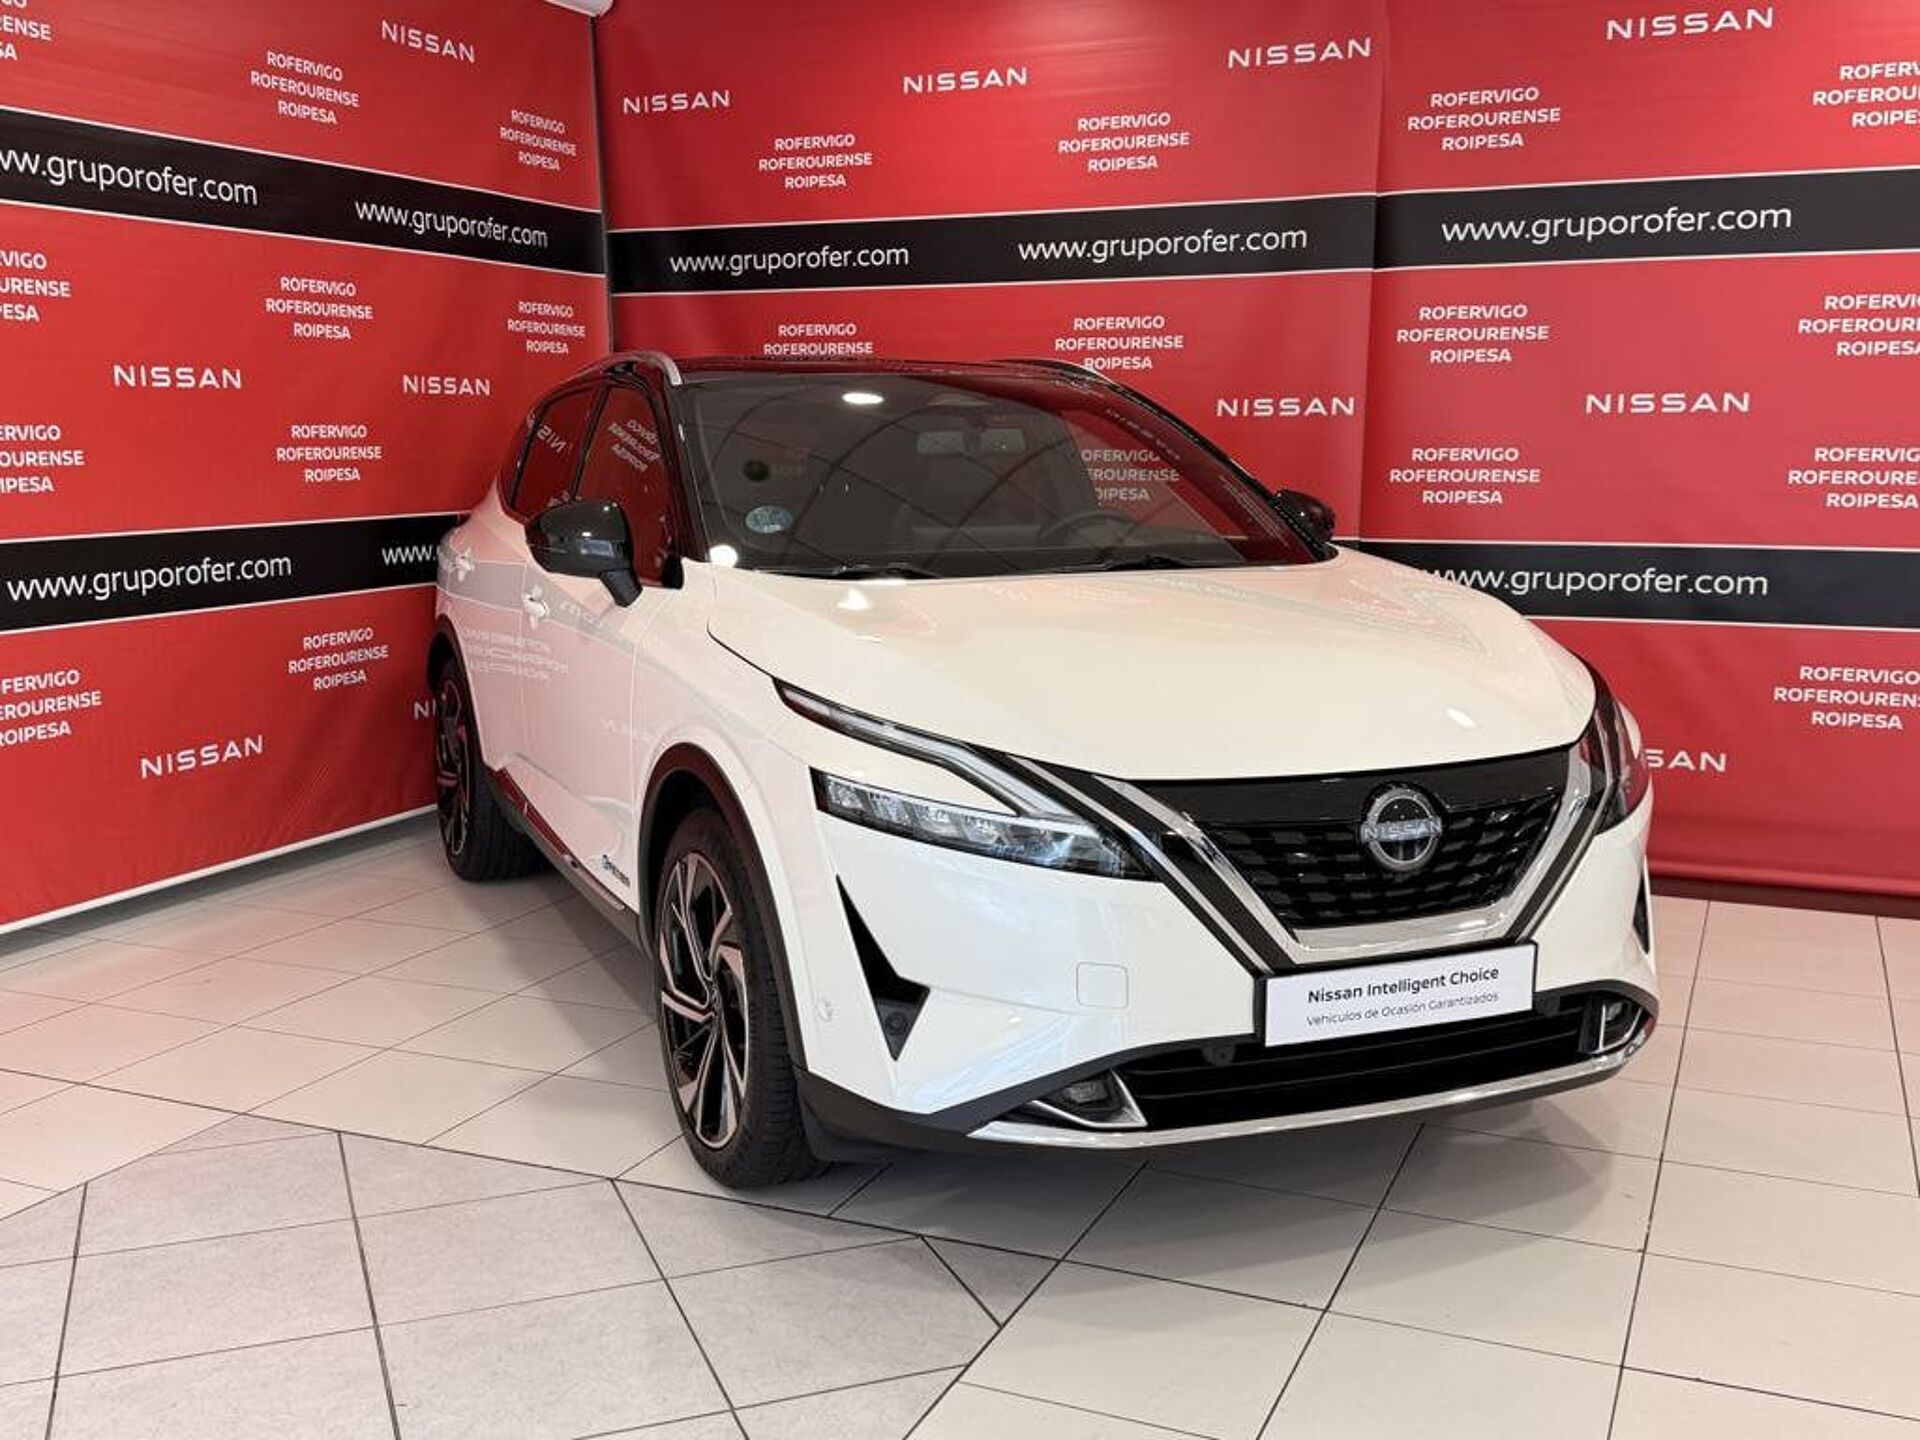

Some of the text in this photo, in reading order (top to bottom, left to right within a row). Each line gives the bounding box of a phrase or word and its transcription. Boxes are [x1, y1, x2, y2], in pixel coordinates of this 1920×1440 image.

[1607, 7, 1772, 40] NISSAN
[382, 20, 474, 62] NISSAN
[1228, 38, 1370, 68] NISSAN
[267, 51, 342, 81] ROFERVIGO
[251, 71, 358, 107] ROFEROURENSE
[904, 67, 1027, 93] NISSAN
[624, 90, 729, 114] NISSAN
[1431, 87, 1539, 107] ROFERVIGO
[278, 100, 336, 124] ROIPESA
[1408, 108, 1560, 130] ROFEROURENSE
[1852, 109, 1920, 126] ROIPE
[511, 110, 565, 134] ROFERVIGO
[1078, 113, 1170, 131] ROFERVIGO
[500, 127, 576, 156] ROFEROURENSE
[775, 134, 855, 150] ROFERVIGO
[1059, 132, 1189, 153] ROFEROURENSE
[1442, 133, 1523, 150] ROIPESA
[519, 151, 560, 170] ROIPESA
[759, 152, 872, 170] ROFEROURENSE
[1088, 156, 1158, 172] ROIPESA
[785, 174, 846, 188] ROIPESA
[355, 202, 547, 246] www.gruporofer.com
[1442, 207, 1791, 244] www.gruporofer.com
[1018, 229, 1307, 263] www.gruporofer.com
[0, 250, 47, 269] VIGO
[670, 246, 908, 276] www.gruporofer.com
[281, 277, 356, 296] ROFERVIGO
[266, 298, 373, 319] ROFEROURENSE
[519, 301, 573, 318] ROFERVIGO
[1825, 294, 1920, 310] ROFERVI
[0, 303, 39, 321] ESA
[1419, 304, 1528, 320] ROFERVIGO
[294, 323, 351, 339] ROIPESA
[508, 319, 585, 337] ROFEROURENSE
[778, 323, 857, 336] ROFERVIGO
[1074, 315, 1165, 330] ROFERVIGO
[1055, 335, 1183, 351] ROFEROURENSE
[1397, 326, 1549, 342] ROFEROURENSE
[527, 340, 568, 354] ROIPESA
[764, 342, 873, 356] ROFEROURENSE
[1430, 349, 1511, 362] ROIPESA
[1083, 357, 1152, 370] ROIPESA
[114, 365, 241, 388] NISSAN
[403, 375, 489, 395] NISSAN
[1217, 397, 1354, 416] NISSAN
[1586, 393, 1749, 413] NISSAN
[291, 425, 367, 438] ROFERVIGO
[277, 446, 381, 461] ROFEROURENSE
[1412, 448, 1519, 461] ROFERVIGO
[304, 468, 360, 482] ROIPESA
[1390, 469, 1540, 483] ROFEROURENSE
[1423, 490, 1502, 504] ROIPESA
[1827, 493, 1918, 508] ROIPESA
[7, 557, 291, 601] www.gruporofer.com
[303, 628, 373, 649] ROFERVIGO
[288, 645, 388, 673] ROFEROURENSE
[313, 670, 366, 690] ROIPESA
[1800, 666, 1920, 685] ROFERVIGO
[1774, 687, 1920, 707] ROFEROUREN
[1812, 711, 1903, 729] ROIPESA
[141, 735, 262, 778] NISSAN
[1362, 817, 1442, 842] NISSAN
[1308, 967, 1499, 1003] Nissan Intelligent Choice
[1364, 1007, 1379, 1020] de
